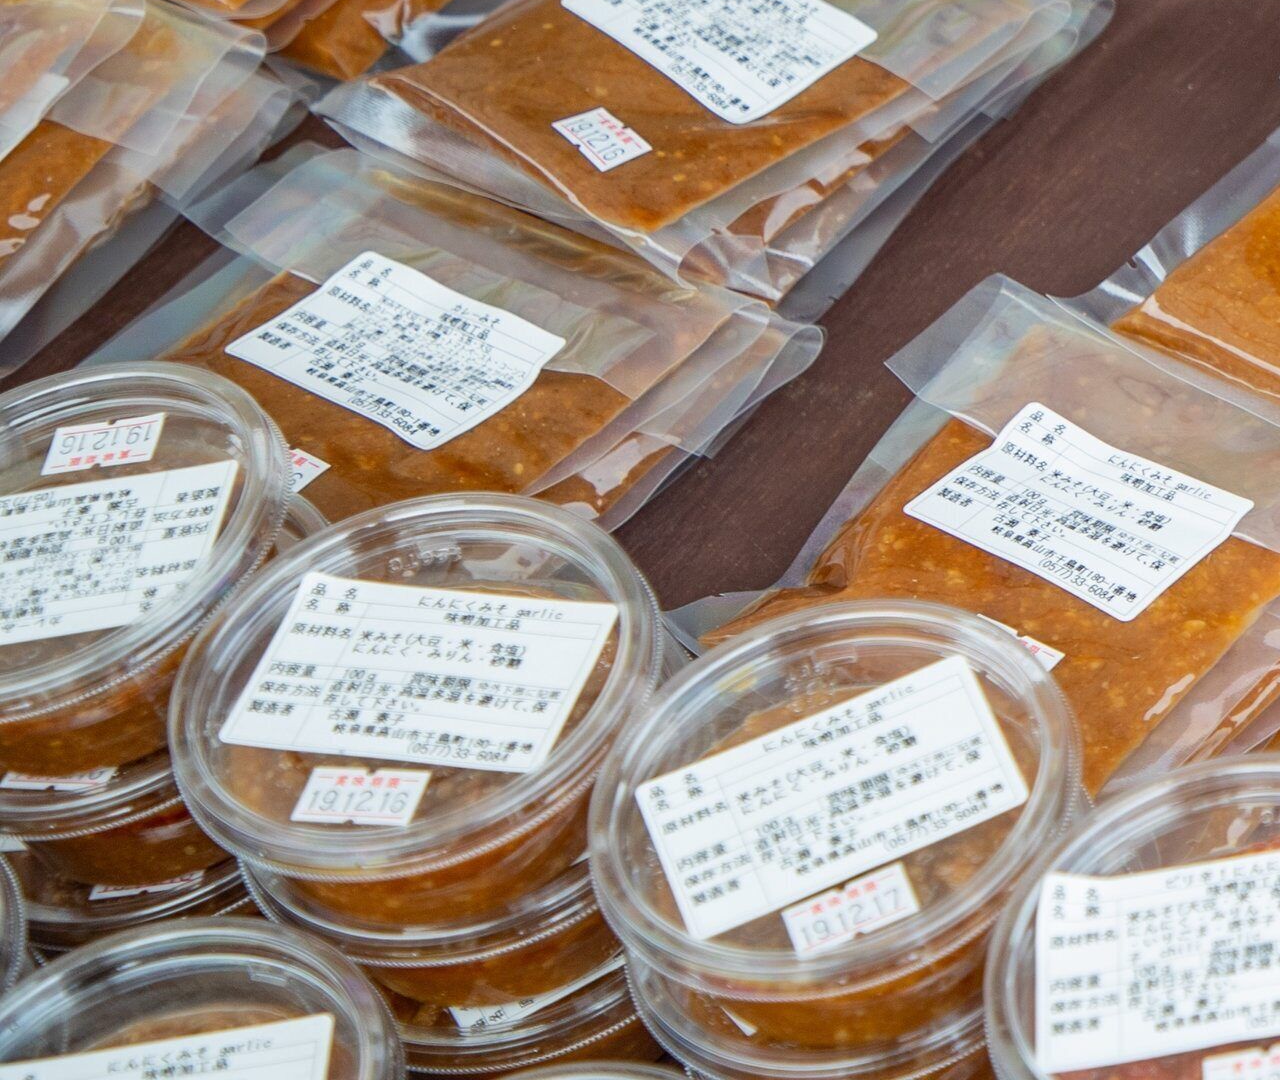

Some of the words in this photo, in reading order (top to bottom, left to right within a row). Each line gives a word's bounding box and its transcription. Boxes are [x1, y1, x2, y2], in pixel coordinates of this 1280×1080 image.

[1000, 441, 1048, 472] 原材料名
[968, 465, 1006, 484] 内容量
[1107, 455, 1173, 484] にんにくみそ
[1174, 483, 1212, 499] garlic
[937, 487, 973, 507] 製造者
[953, 476, 1001, 501] 保存方法
[1038, 558, 1117, 602] (0577)33-6084
[417, 596, 507, 615] にんにくみそ
[514, 609, 563, 620] garlic
[290, 622, 352, 639] 原材料名
[268, 662, 316, 677] 内容量
[259, 681, 322, 698] 保存方法
[865, 686, 914, 712] garlic
[308, 789, 410, 813] 19.12.16
